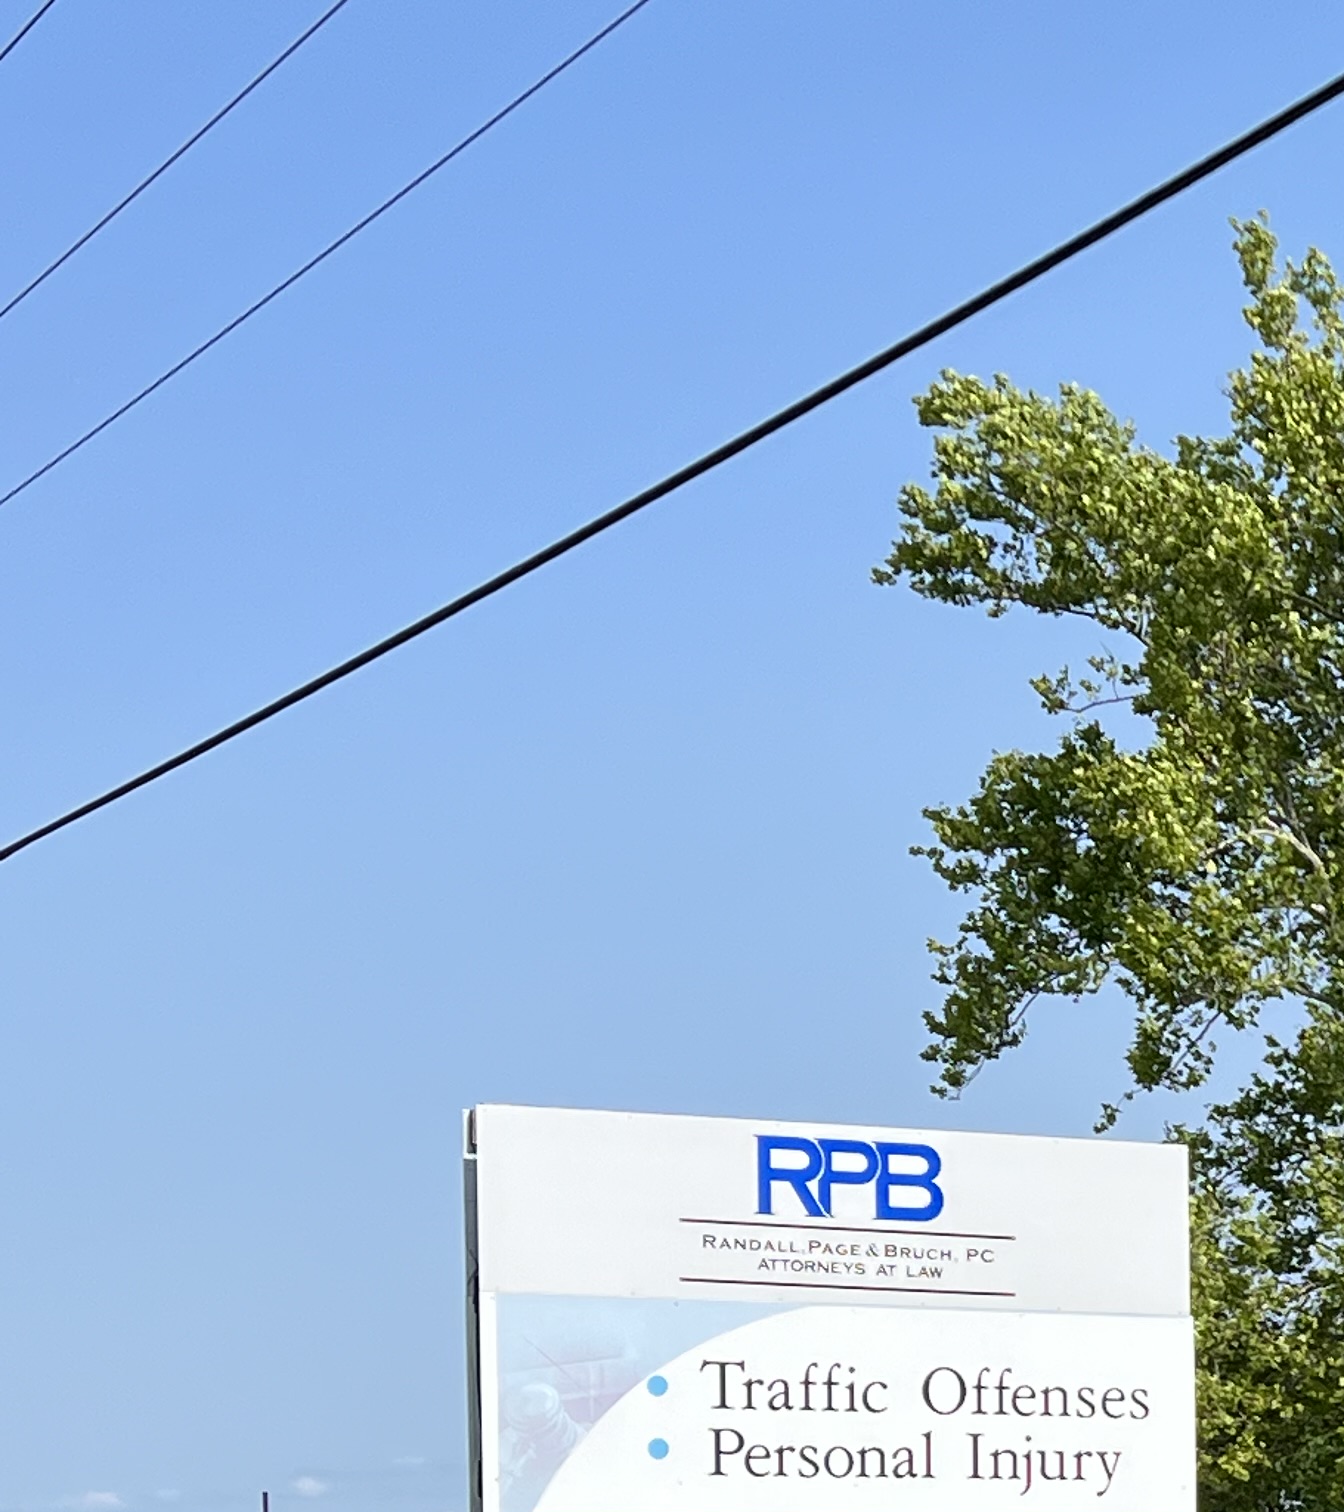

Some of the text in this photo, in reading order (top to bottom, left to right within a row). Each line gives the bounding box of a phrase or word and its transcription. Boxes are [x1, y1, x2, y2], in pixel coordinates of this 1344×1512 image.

[754, 1134, 944, 1222] RPB
[757, 1257, 944, 1279] ATTORNEYS AT LAW
[966, 1248, 995, 1264] PC
[700, 1359, 1151, 1420] Traffic Offenses
[706, 1428, 1122, 1497] Personal Injury
